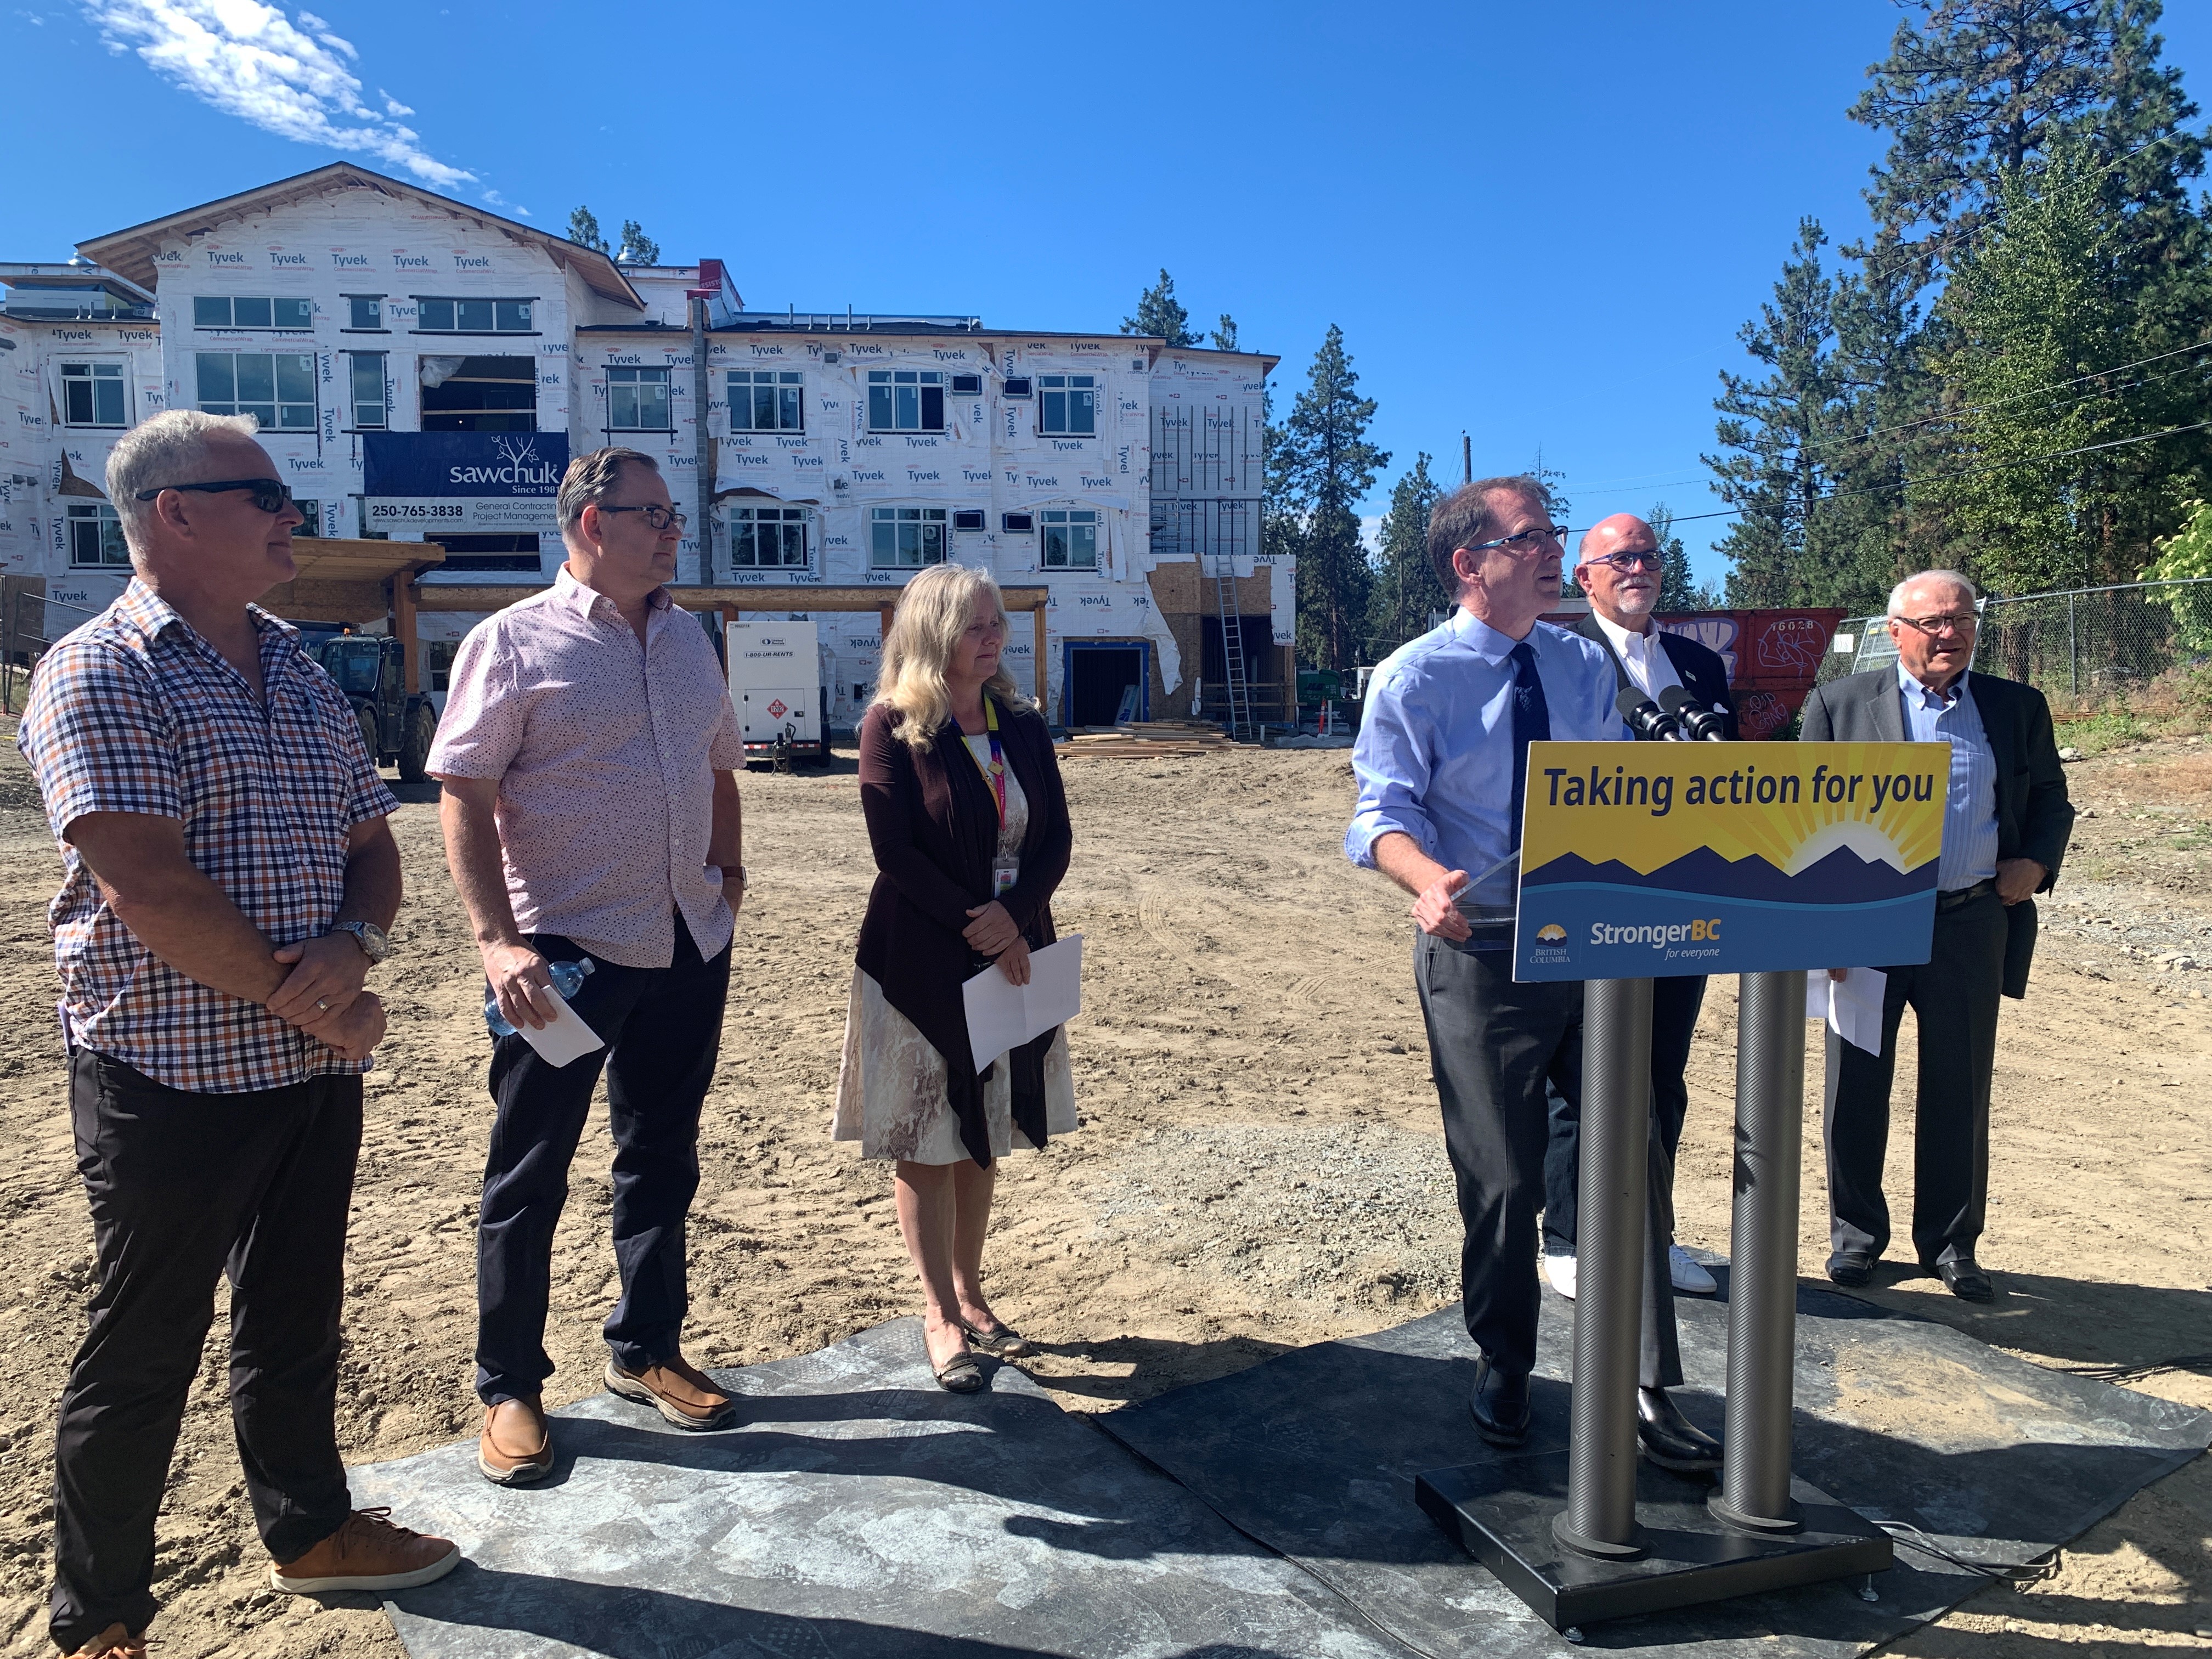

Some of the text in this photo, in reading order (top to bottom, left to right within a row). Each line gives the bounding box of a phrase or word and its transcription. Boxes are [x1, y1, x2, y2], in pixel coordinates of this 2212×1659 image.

[207, 251, 244, 264] Tyvek
[270, 252, 306, 266] Tyvek
[331, 255, 368, 267] Tyvek
[393, 256, 429, 268] Tyvek
[454, 256, 489, 269] Tyvek
[389, 305, 416, 317] Tyve
[57, 329, 92, 341] Tyvek
[117, 330, 153, 342] Tyvek
[750, 345, 783, 357] Tyvek
[850, 343, 882, 356] Tyvek
[934, 349, 966, 361] Tyvek
[608, 354, 641, 365] Tyvek
[319, 353, 334, 384] yvek
[1243, 382, 1263, 392] yvek
[18, 411, 43, 426] Tyve
[974, 404, 983, 424] vek
[321, 408, 336, 443] Tyvek
[1005, 407, 1017, 438] Tyvek
[1160, 417, 1187, 427] Tyvek
[775, 437, 808, 448] Tyvek
[856, 437, 882, 448] yvek
[905, 437, 937, 448] Tyvek
[1052, 440, 1083, 451] Tyvek
[1052, 440, 1083, 451] Tyvek
[288, 458, 324, 471] Tyvek
[736, 454, 768, 466] Tyvek
[792, 456, 823, 467] Tyvek
[450, 461, 560, 483] sawchuk
[852, 470, 884, 482] Tyvek
[907, 471, 940, 482] Tyvek
[1026, 476, 1058, 488] Tyvek
[1081, 477, 1112, 488] Tyvek
[512, 485, 536, 494] Since
[373, 505, 462, 516] 250-765-3838
[476, 502, 556, 510] General Contractin
[324, 503, 338, 537] Tyvek
[473, 512, 557, 521] Project Manageme
[52, 516, 65, 549] Tyvek
[681, 540, 700, 550] Tyv
[1253, 555, 1277, 565] Tyve
[732, 572, 765, 583] Tyvek
[865, 572, 890, 583] yvek
[1080, 595, 1111, 607] Tyvek
[1544, 765, 1933, 816] Taking action for you
[1590, 919, 1722, 949] StrongerBC
[1530, 956, 1571, 964] COLUMBIA
[1664, 947, 1720, 961] for everyone
